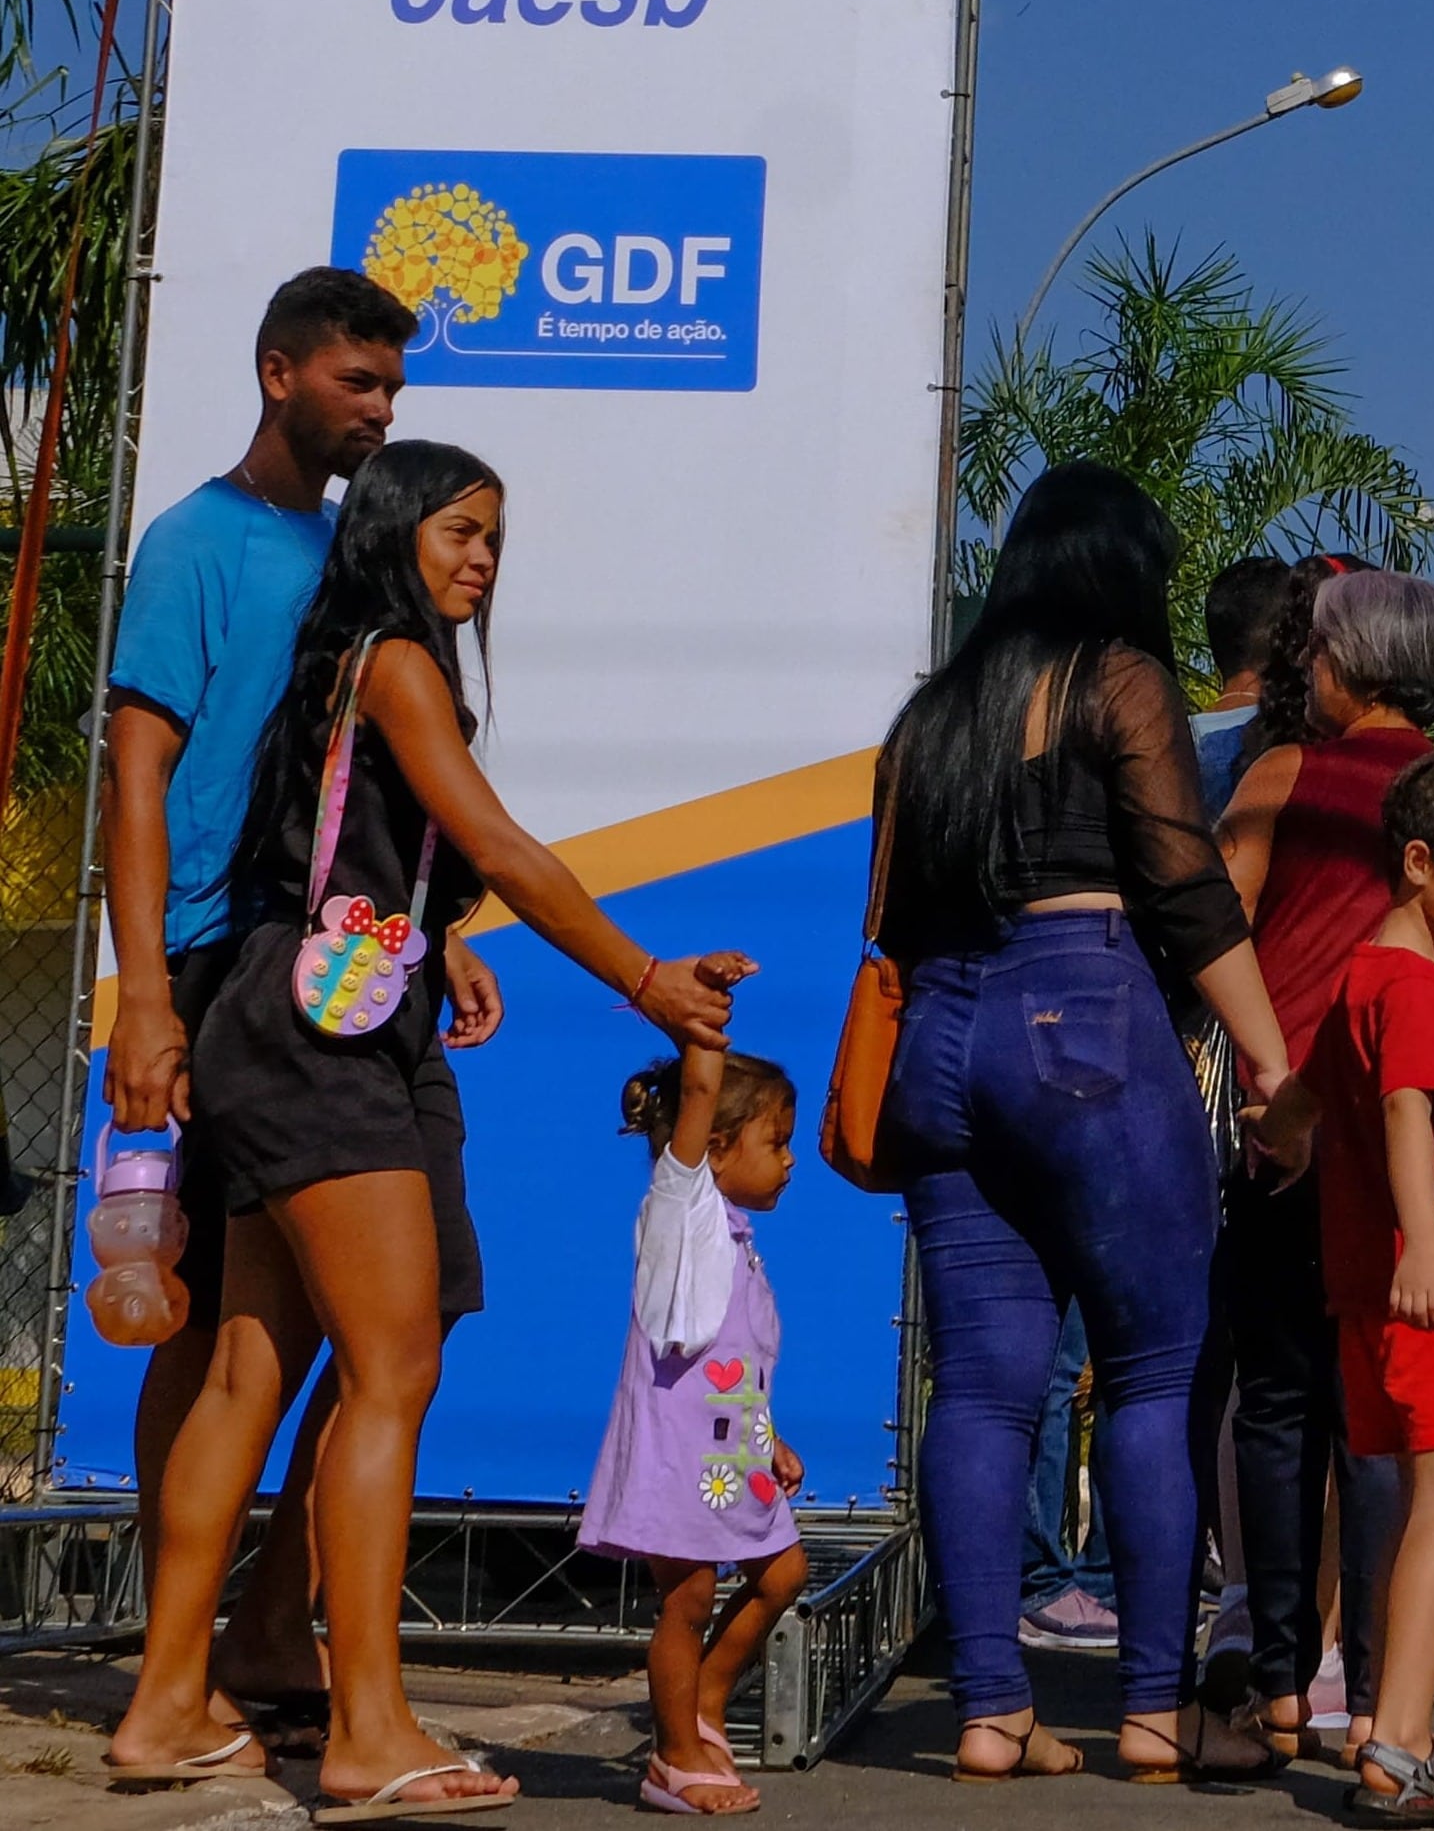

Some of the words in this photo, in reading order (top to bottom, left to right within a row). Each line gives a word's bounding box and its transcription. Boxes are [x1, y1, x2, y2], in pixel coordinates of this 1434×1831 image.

[542, 233, 730, 304] GDF
[539, 312, 553, 336] É
[558, 319, 629, 342] tempo
[634, 320, 662, 339] de
[667, 320, 726, 344] ação.
